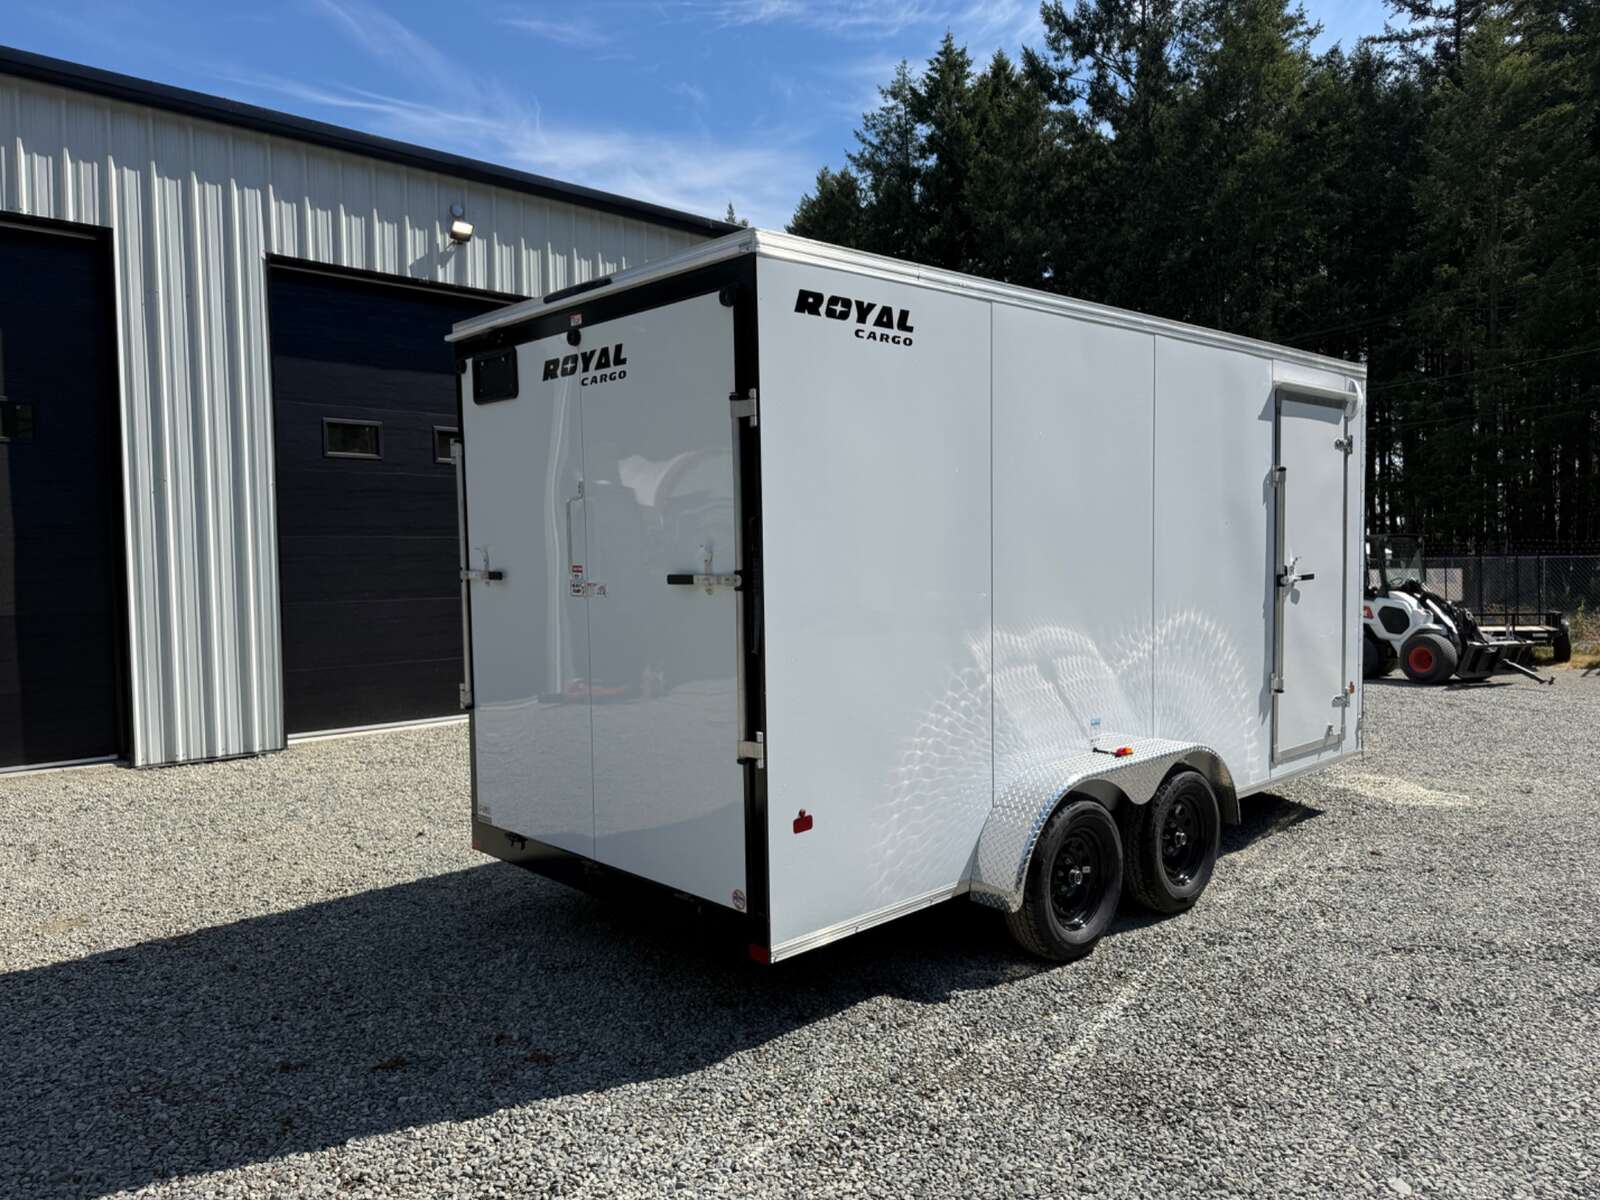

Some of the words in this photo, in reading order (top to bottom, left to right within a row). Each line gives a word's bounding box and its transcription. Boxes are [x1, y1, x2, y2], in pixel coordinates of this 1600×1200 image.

[794, 288, 914, 333] ROYAL
[854, 329, 913, 347] CARGO
[543, 343, 627, 382] ROYAL
[581, 370, 627, 386] CARGO
